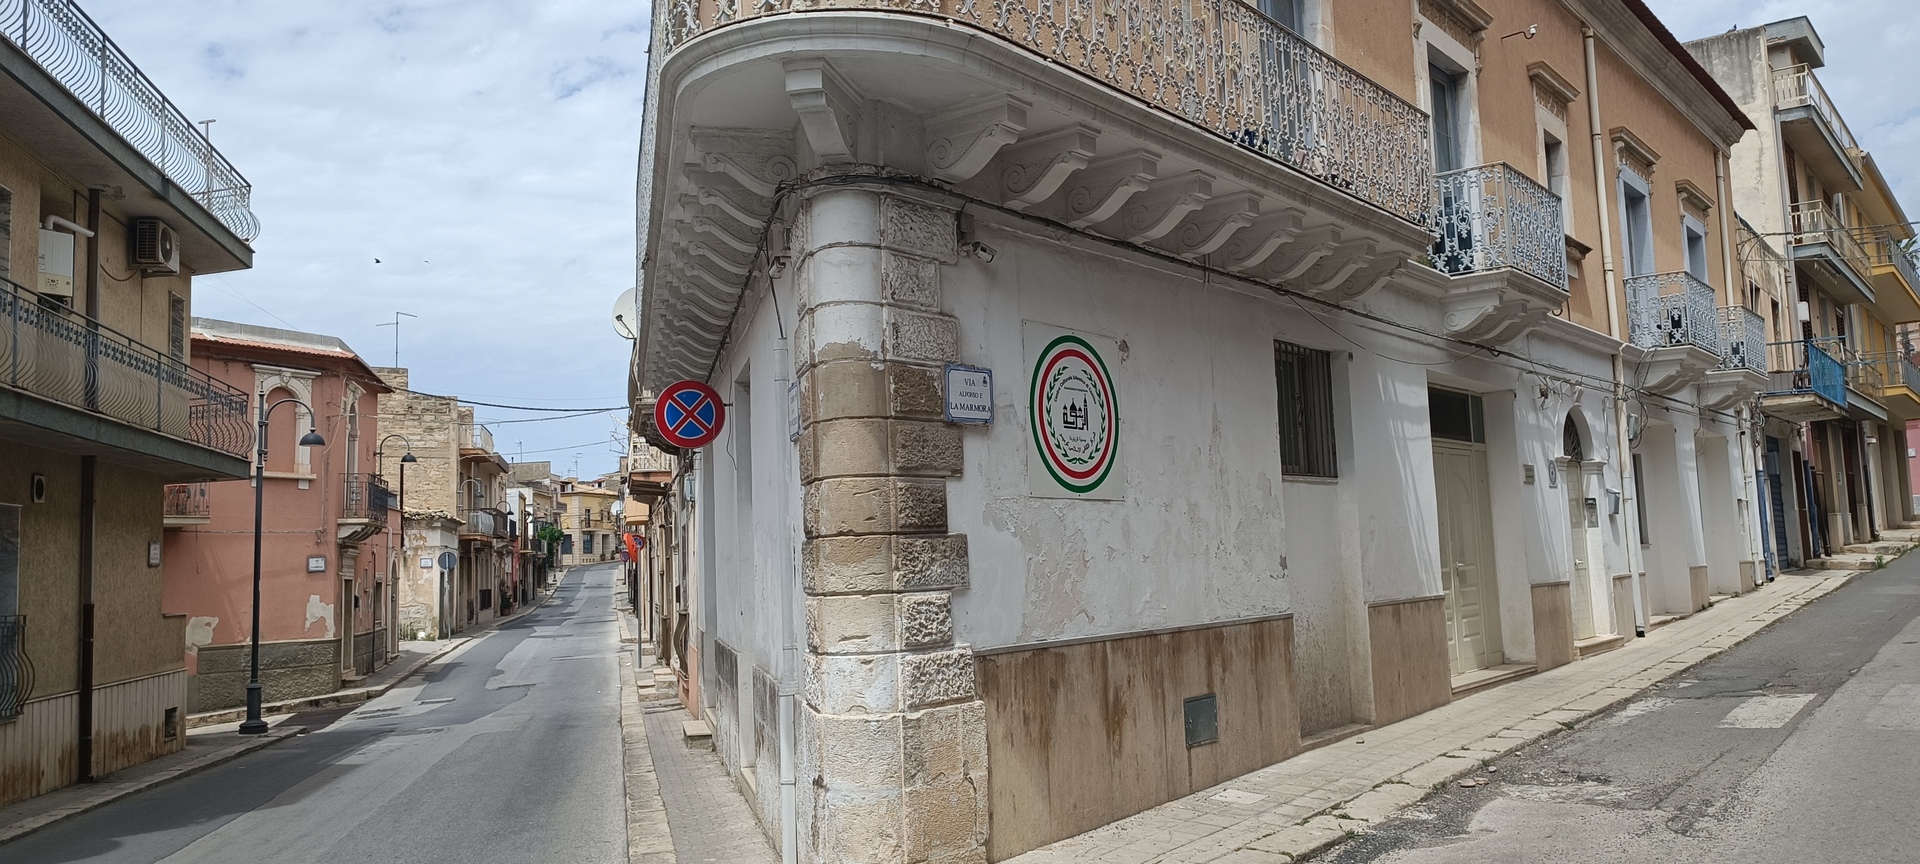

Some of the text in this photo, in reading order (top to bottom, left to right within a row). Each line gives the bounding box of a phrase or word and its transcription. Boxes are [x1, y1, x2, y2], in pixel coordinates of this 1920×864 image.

[964, 378, 976, 386] VIA
[950, 402, 991, 412] LA MARMORA
